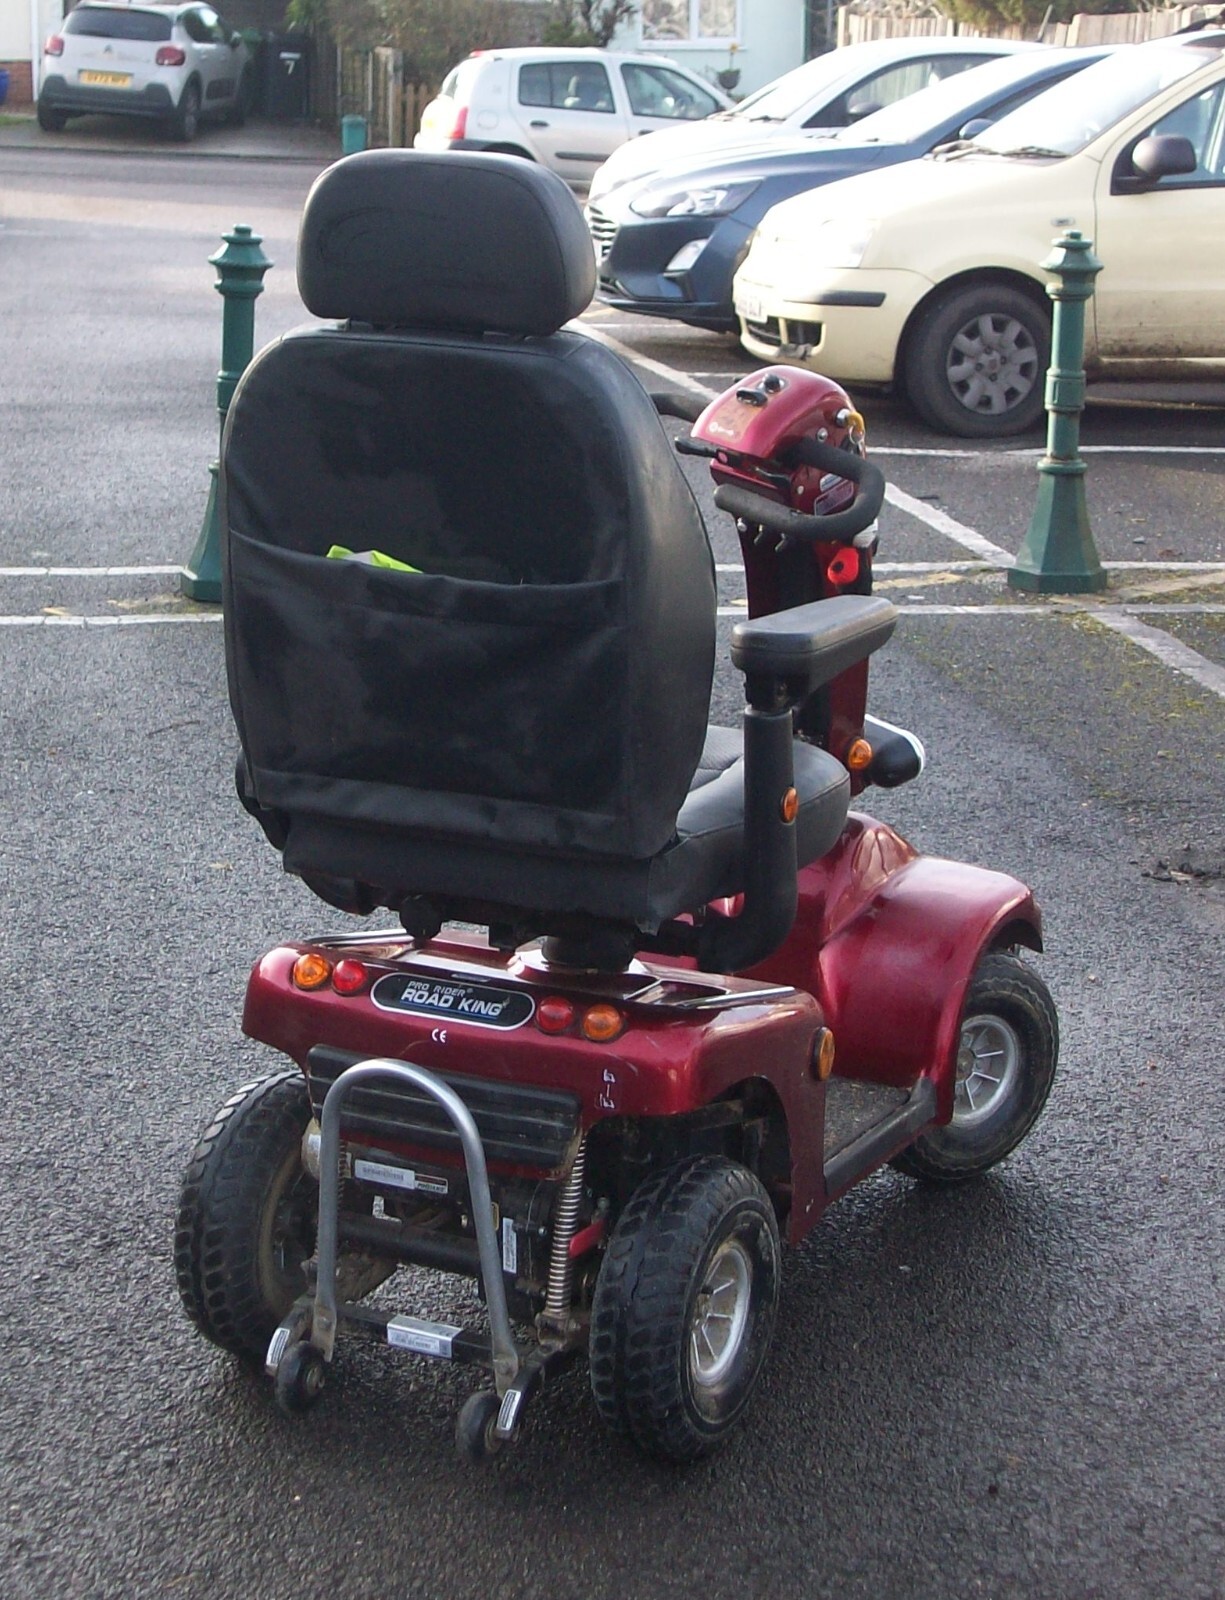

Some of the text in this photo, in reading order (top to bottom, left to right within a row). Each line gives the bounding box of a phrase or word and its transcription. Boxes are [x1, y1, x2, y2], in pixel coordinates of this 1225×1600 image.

[285, 60, 295, 75] 7
[407, 980, 430, 991] PRO
[400, 988, 502, 1016] ROAD KING
[431, 1028, 447, 1043] CE
